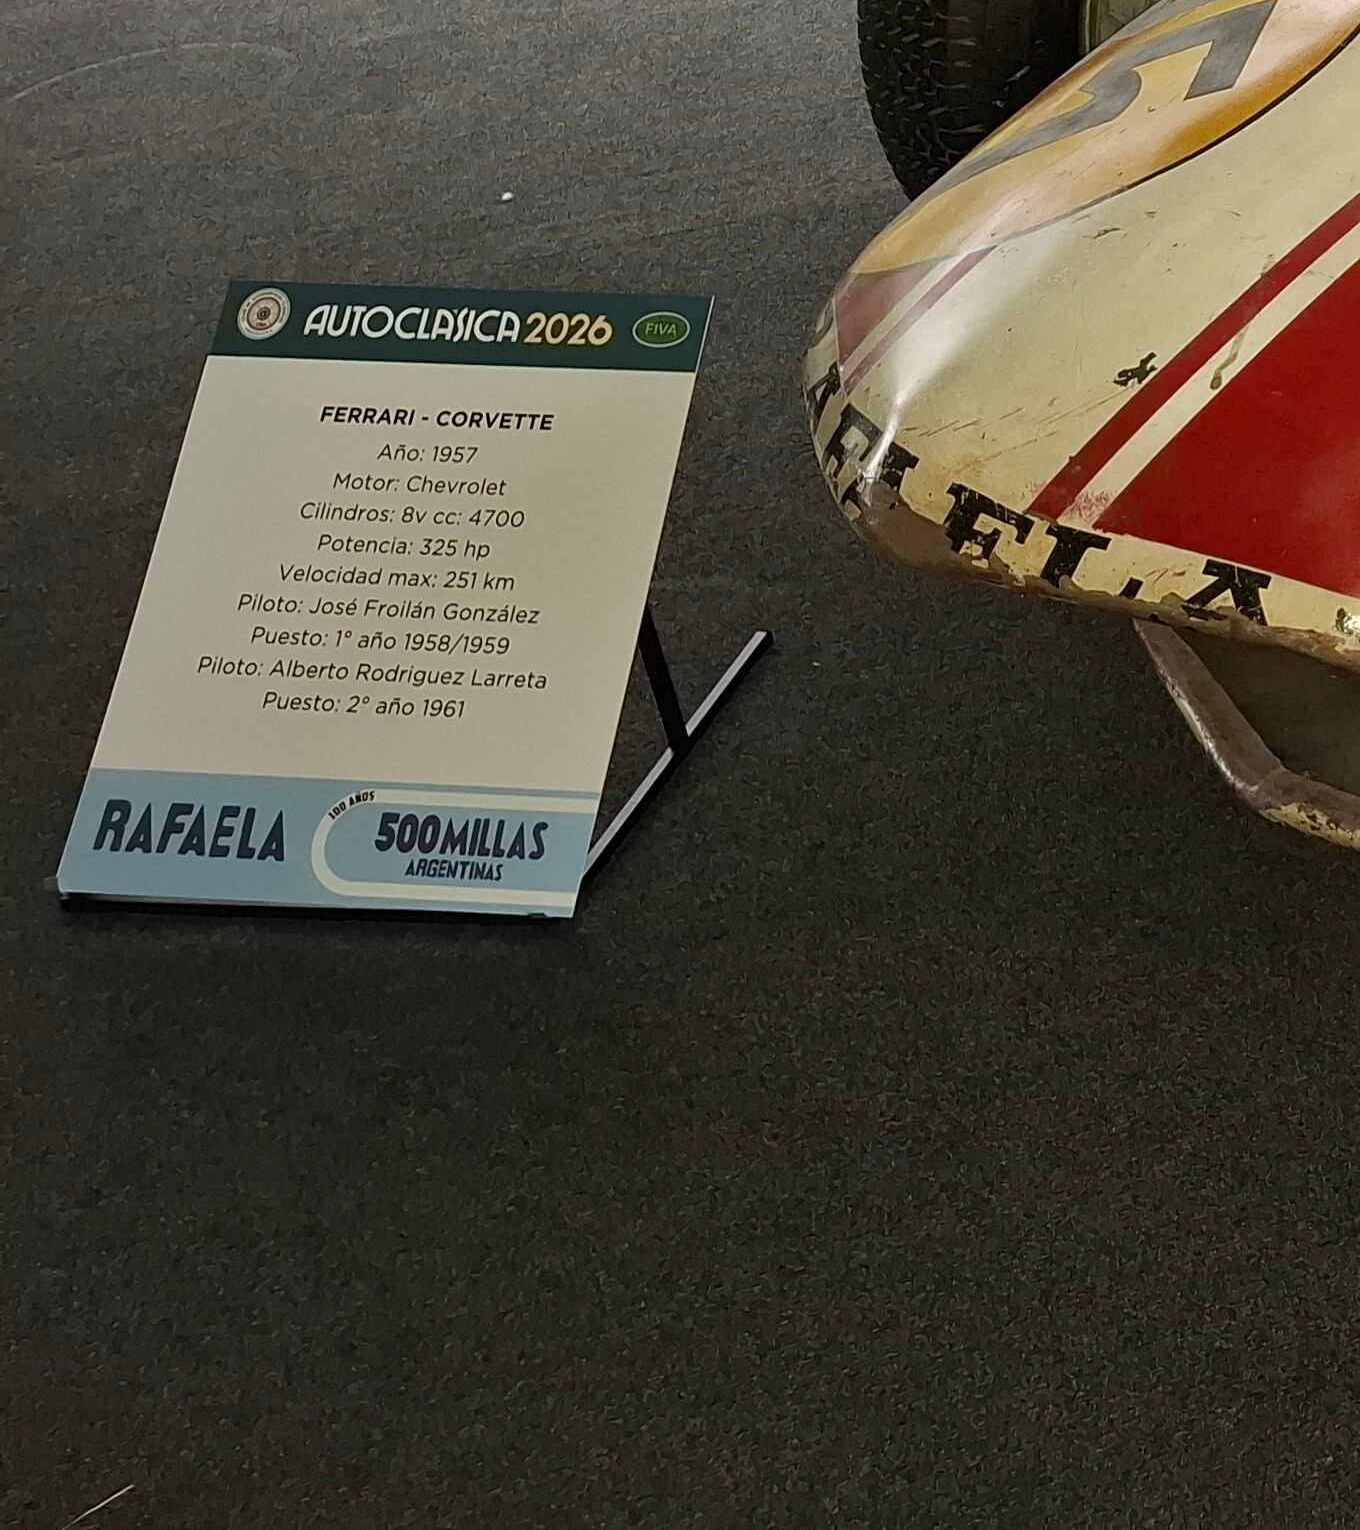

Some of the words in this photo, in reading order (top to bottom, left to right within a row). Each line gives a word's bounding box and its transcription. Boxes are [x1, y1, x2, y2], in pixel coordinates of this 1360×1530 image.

[524, 311, 612, 347] 2026
[644, 322, 678, 338] FIVA
[319, 406, 415, 426] FERRARI
[436, 410, 555, 431] CORVETTE
[377, 444, 424, 463] Año:
[432, 445, 479, 464] 1957
[332, 473, 400, 492] Motor:
[406, 475, 507, 496] Chevrolet
[300, 502, 396, 523] Cilindros:
[401, 506, 428, 524] 8v
[433, 512, 462, 526] cc:
[468, 510, 525, 528] 4700
[317, 534, 414, 556] Potencia:
[419, 538, 458, 558] 325
[463, 539, 491, 561] hp
[279, 564, 382, 586] Velocidad
[388, 573, 438, 588] max:
[443, 571, 477, 590] 251
[482, 572, 515, 591] km
[237, 593, 302, 614] Piloto:
[309, 597, 358, 617] José
[363, 599, 436, 620] Froilán
[443, 602, 541, 624] González
[251, 626, 328, 648] Puesto:
[357, 631, 397, 651] año
[404, 632, 511, 655] 1958/1959
[197, 656, 264, 676] Piloto:
[269, 659, 349, 681] Alberto
[355, 663, 465, 688] Rodriguez
[470, 668, 547, 690] Larreta
[262, 691, 341, 713] Puesto:
[375, 697, 415, 717] año
[422, 698, 466, 719] 1961
[93, 798, 285, 862] RAFAELA
[404, 857, 504, 882] ARGENTINAS
